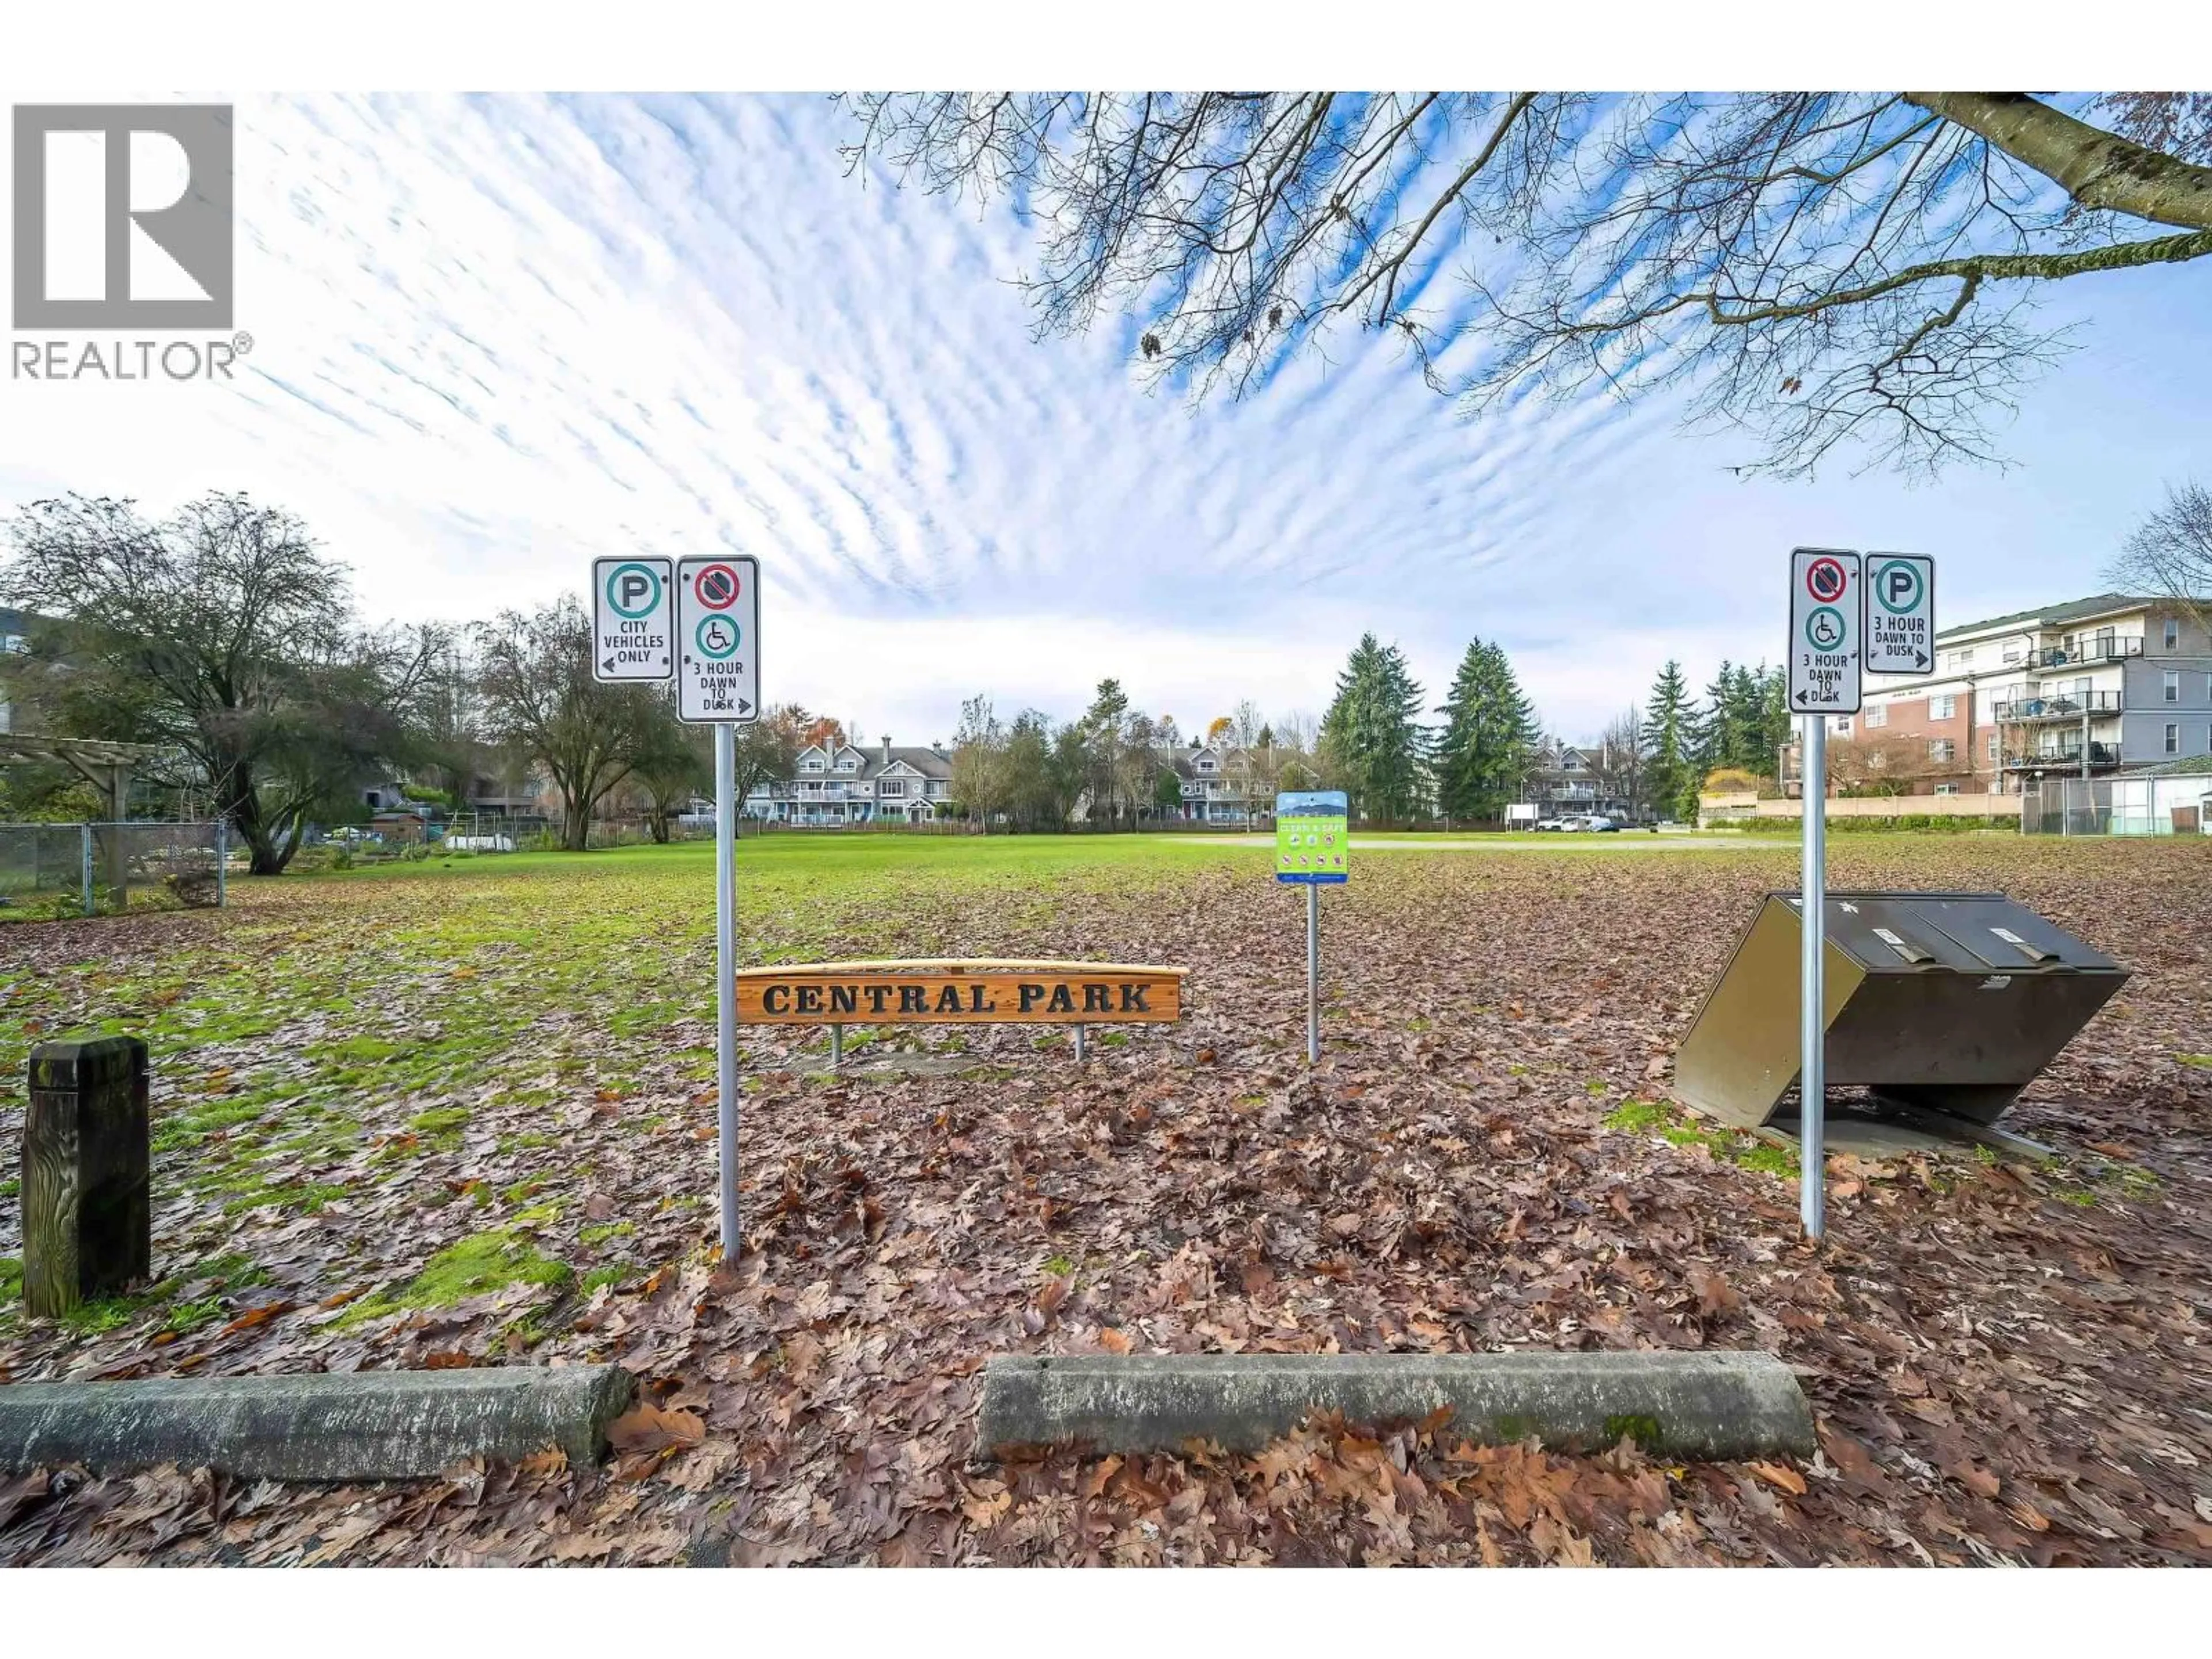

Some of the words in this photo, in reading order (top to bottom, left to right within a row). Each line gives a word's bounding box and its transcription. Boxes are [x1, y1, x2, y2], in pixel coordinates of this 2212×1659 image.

[622, 575, 648, 608] P
[1889, 572, 1912, 603] P
[620, 621, 647, 633] CITY
[1874, 616, 1881, 630] 3
[1888, 616, 1925, 631] HOUR
[604, 635, 664, 648] VEHICLES
[1875, 631, 1906, 644] DAWN
[1911, 633, 1925, 645] TO
[618, 650, 651, 663] ONLY
[1886, 645, 1914, 657] DUSK
[1803, 653, 1810, 667] 3
[1815, 654, 1848, 668] HOUR
[694, 662, 700, 675] 3
[707, 661, 744, 675] HOUR
[1809, 669, 1842, 681] DAWN
[700, 677, 737, 688] DAWN
[1818, 680, 1832, 691] TO
[711, 689, 726, 699] TO
[763, 984, 998, 1016] CENTRAL
[1017, 983, 1153, 1014] PARK
